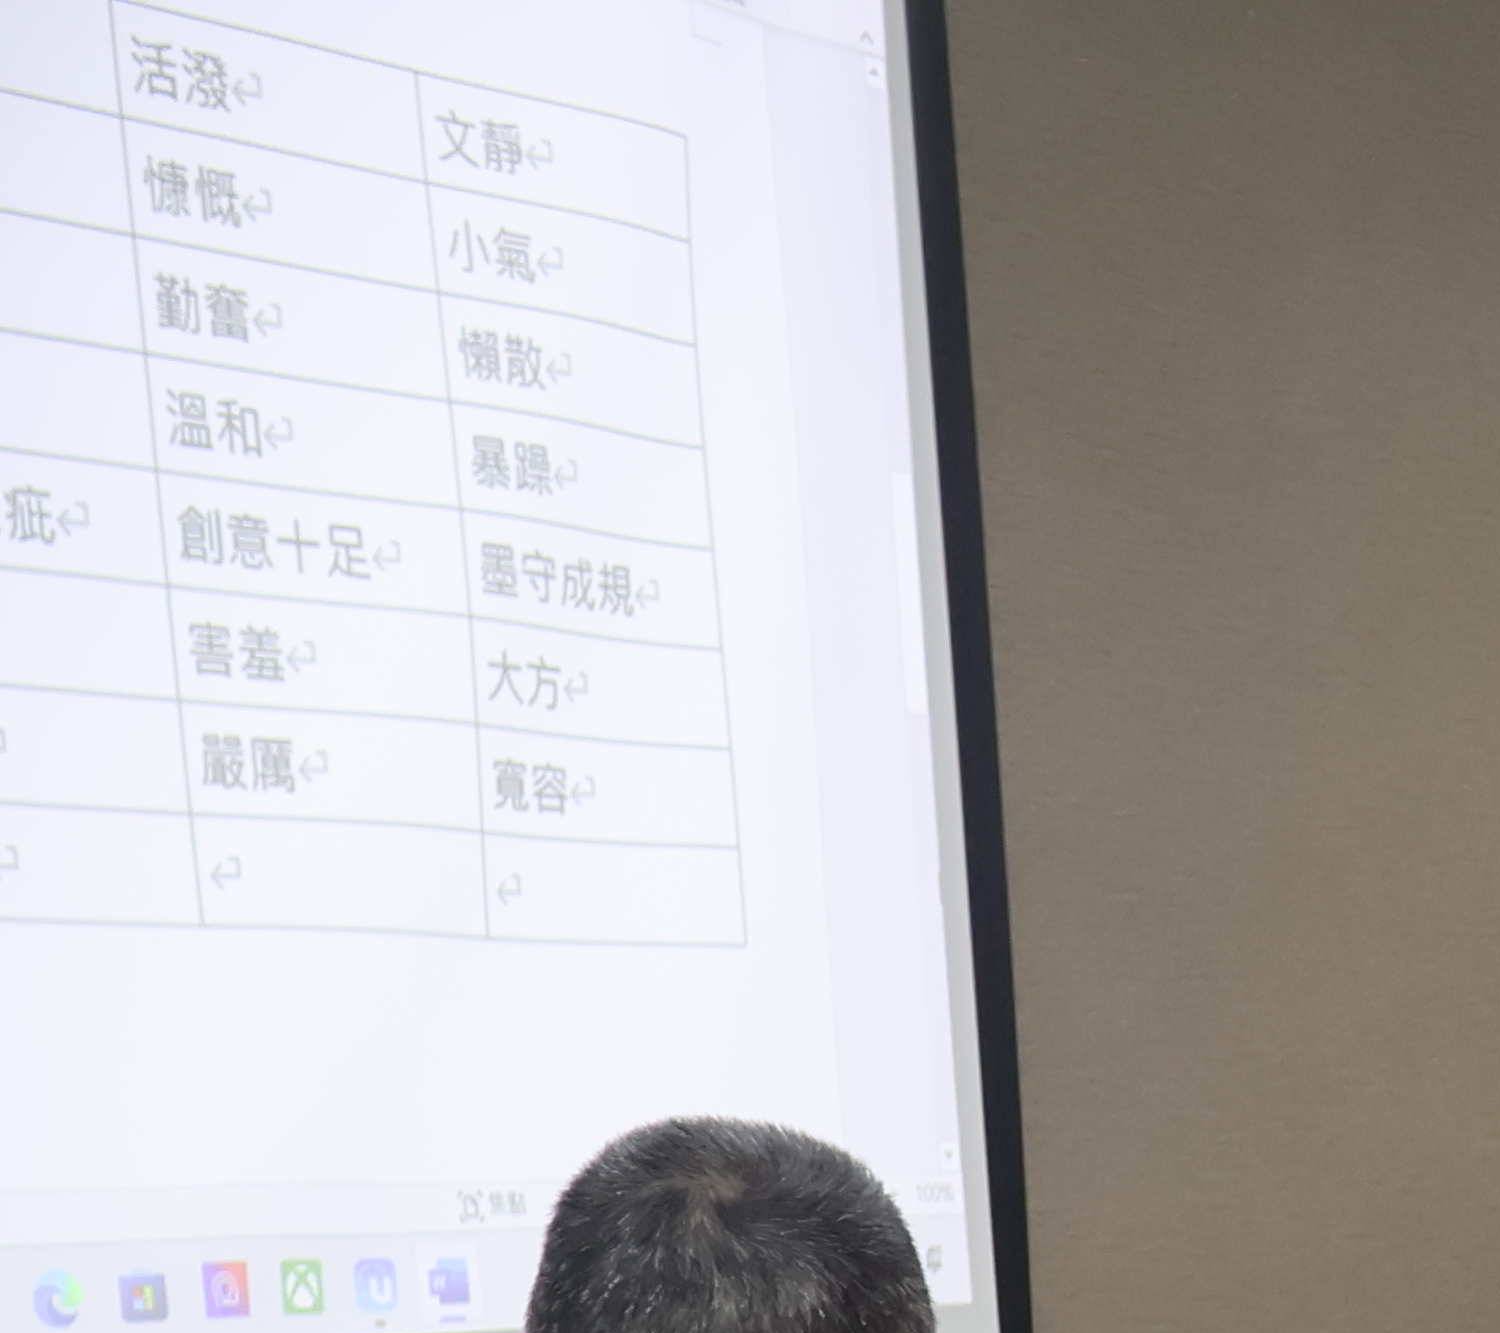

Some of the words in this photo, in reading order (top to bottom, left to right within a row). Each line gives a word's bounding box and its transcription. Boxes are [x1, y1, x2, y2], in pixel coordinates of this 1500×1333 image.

[131, 35, 232, 113] 活潑
[434, 109, 523, 175] 文靜
[143, 154, 243, 229] 慷慨
[449, 218, 537, 285] 小氣
[154, 272, 250, 344] 勤奮
[458, 325, 547, 391] 懶散
[166, 389, 264, 459] 溫和
[472, 433, 554, 496] 暴躁
[0, 484, 57, 546] 疵
[177, 505, 373, 580] 創意十足
[480, 541, 636, 618] 墨守成規
[188, 621, 286, 682] 害羞
[487, 650, 562, 712] 大方
[201, 732, 296, 794] 嚴厲
[492, 757, 569, 816] 寬容
